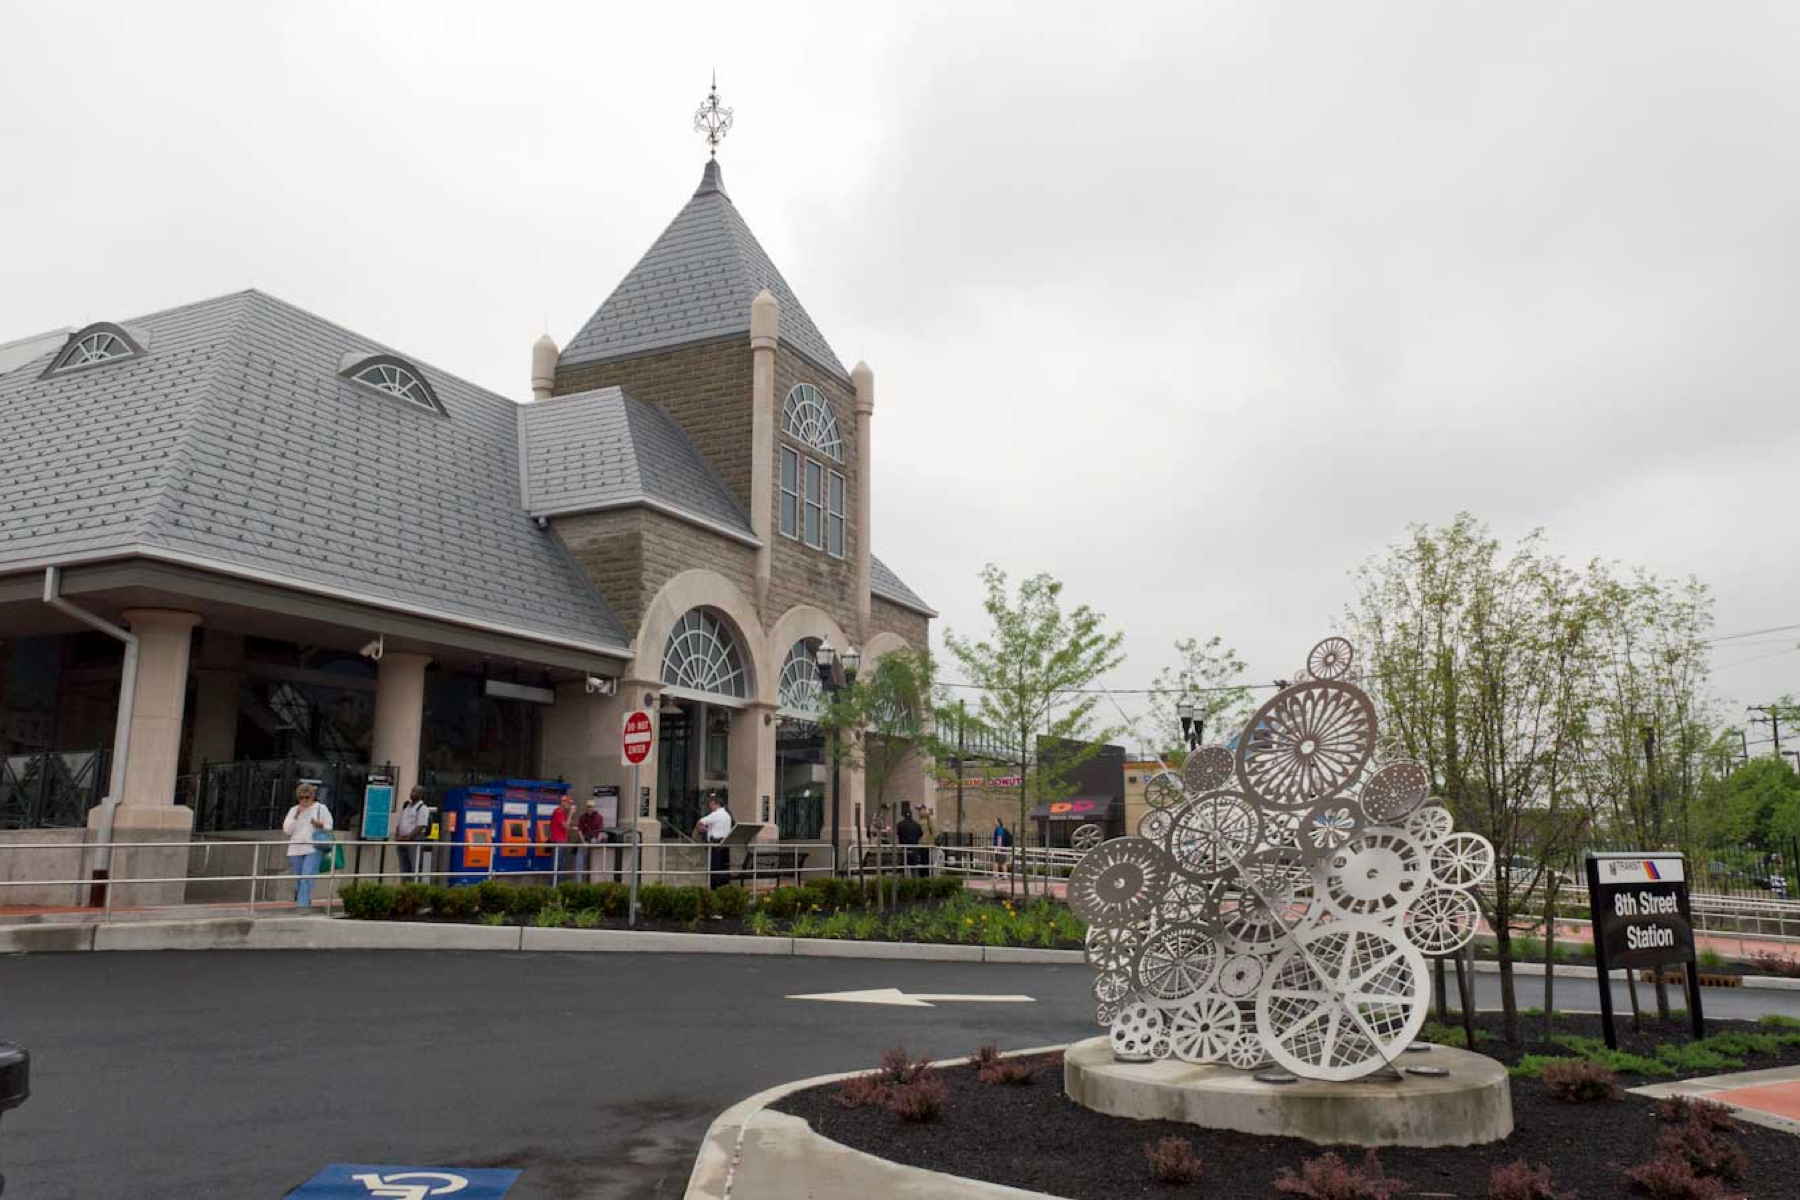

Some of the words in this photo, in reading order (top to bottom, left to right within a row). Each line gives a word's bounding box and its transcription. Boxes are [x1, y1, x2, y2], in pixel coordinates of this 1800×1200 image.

[637, 720, 649, 730] NOT
[628, 743, 646, 754] ENTER
[1614, 892, 1637, 917] 8th
[1640, 891, 1679, 915] Street
[1626, 923, 1674, 949] Station
